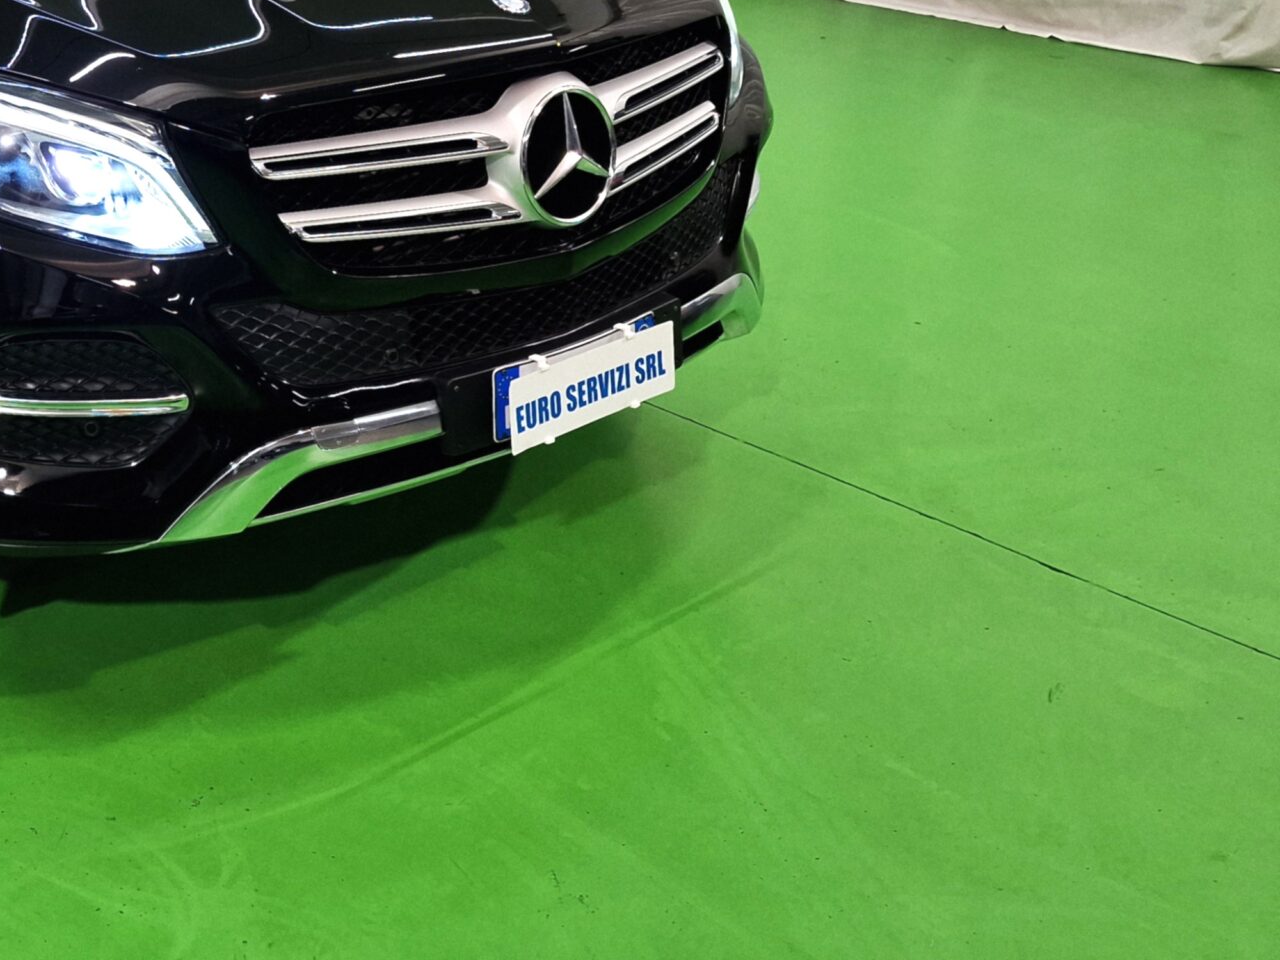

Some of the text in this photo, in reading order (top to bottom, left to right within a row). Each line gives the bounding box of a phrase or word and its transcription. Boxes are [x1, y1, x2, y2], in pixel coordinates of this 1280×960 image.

[515, 350, 667, 434] EURO SERVIZI SRL
